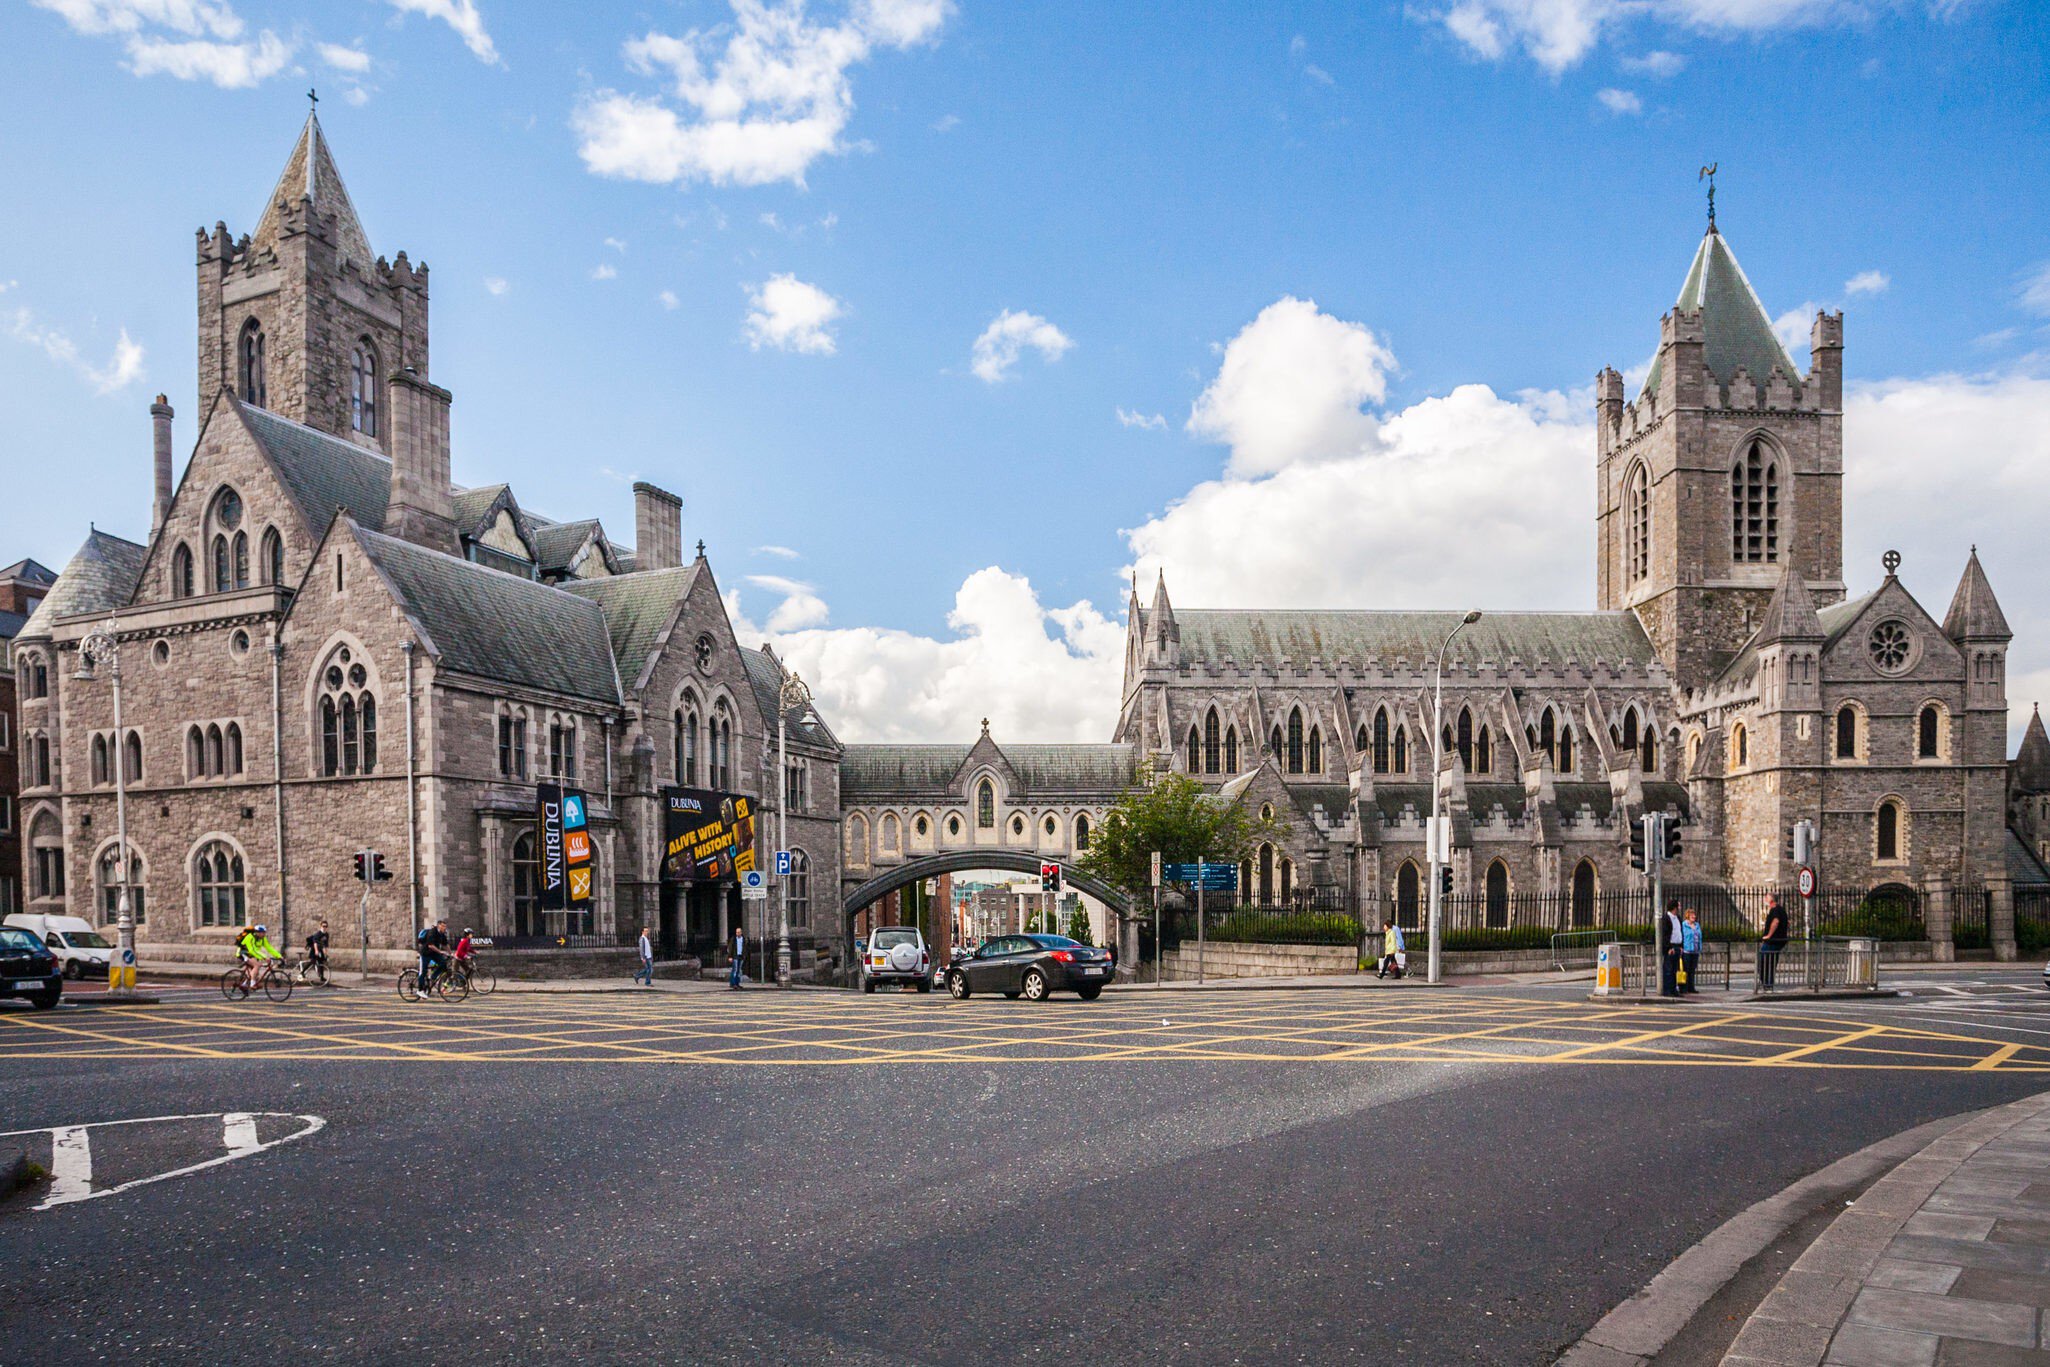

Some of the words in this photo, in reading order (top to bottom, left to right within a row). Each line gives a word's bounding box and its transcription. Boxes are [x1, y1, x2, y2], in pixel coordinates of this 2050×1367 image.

[671, 797, 702, 810] DUBLINIA
[669, 831, 697, 856] ALIVE
[697, 820, 722, 841] WITH
[545, 803, 560, 890] DUBLINIA
[694, 832, 732, 859] HISTORY
[779, 860, 789, 873] P
[1801, 874, 1811, 888] 30
[470, 937, 493, 945] BLINIA
